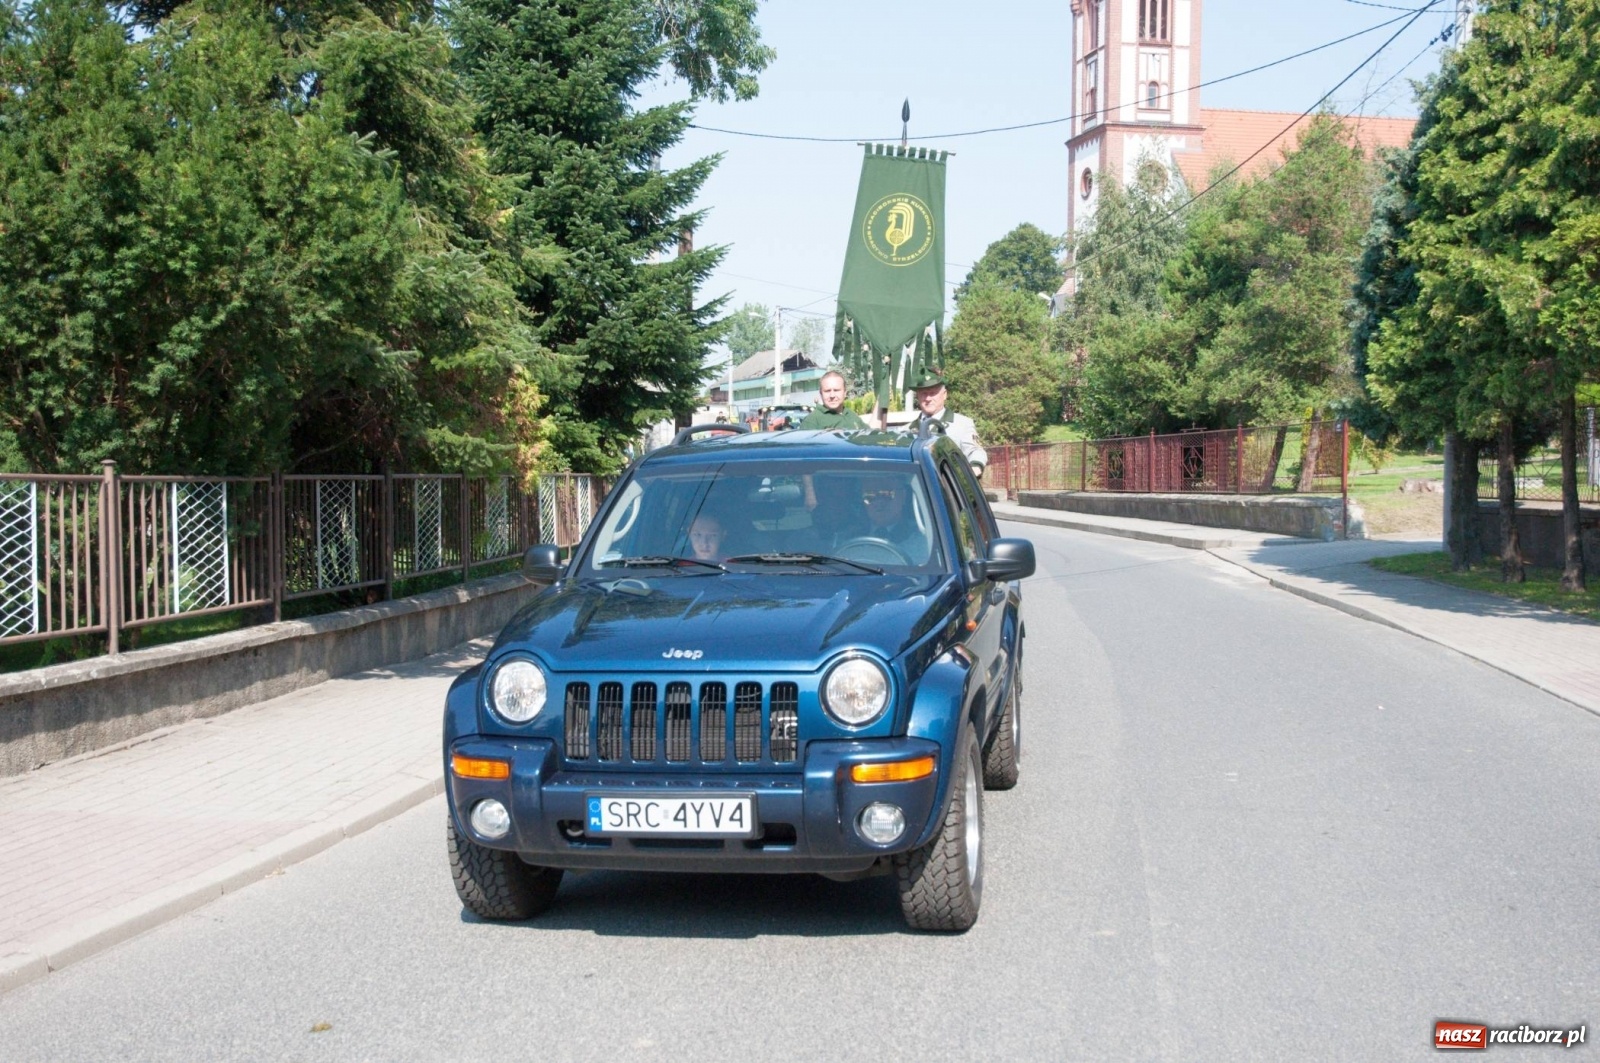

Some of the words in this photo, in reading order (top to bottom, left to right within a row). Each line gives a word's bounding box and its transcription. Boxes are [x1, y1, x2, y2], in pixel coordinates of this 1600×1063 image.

[662, 647, 703, 660] Jeep
[591, 817, 602, 826] PL
[608, 801, 660, 828] SRC
[673, 801, 743, 829] 4YV4
